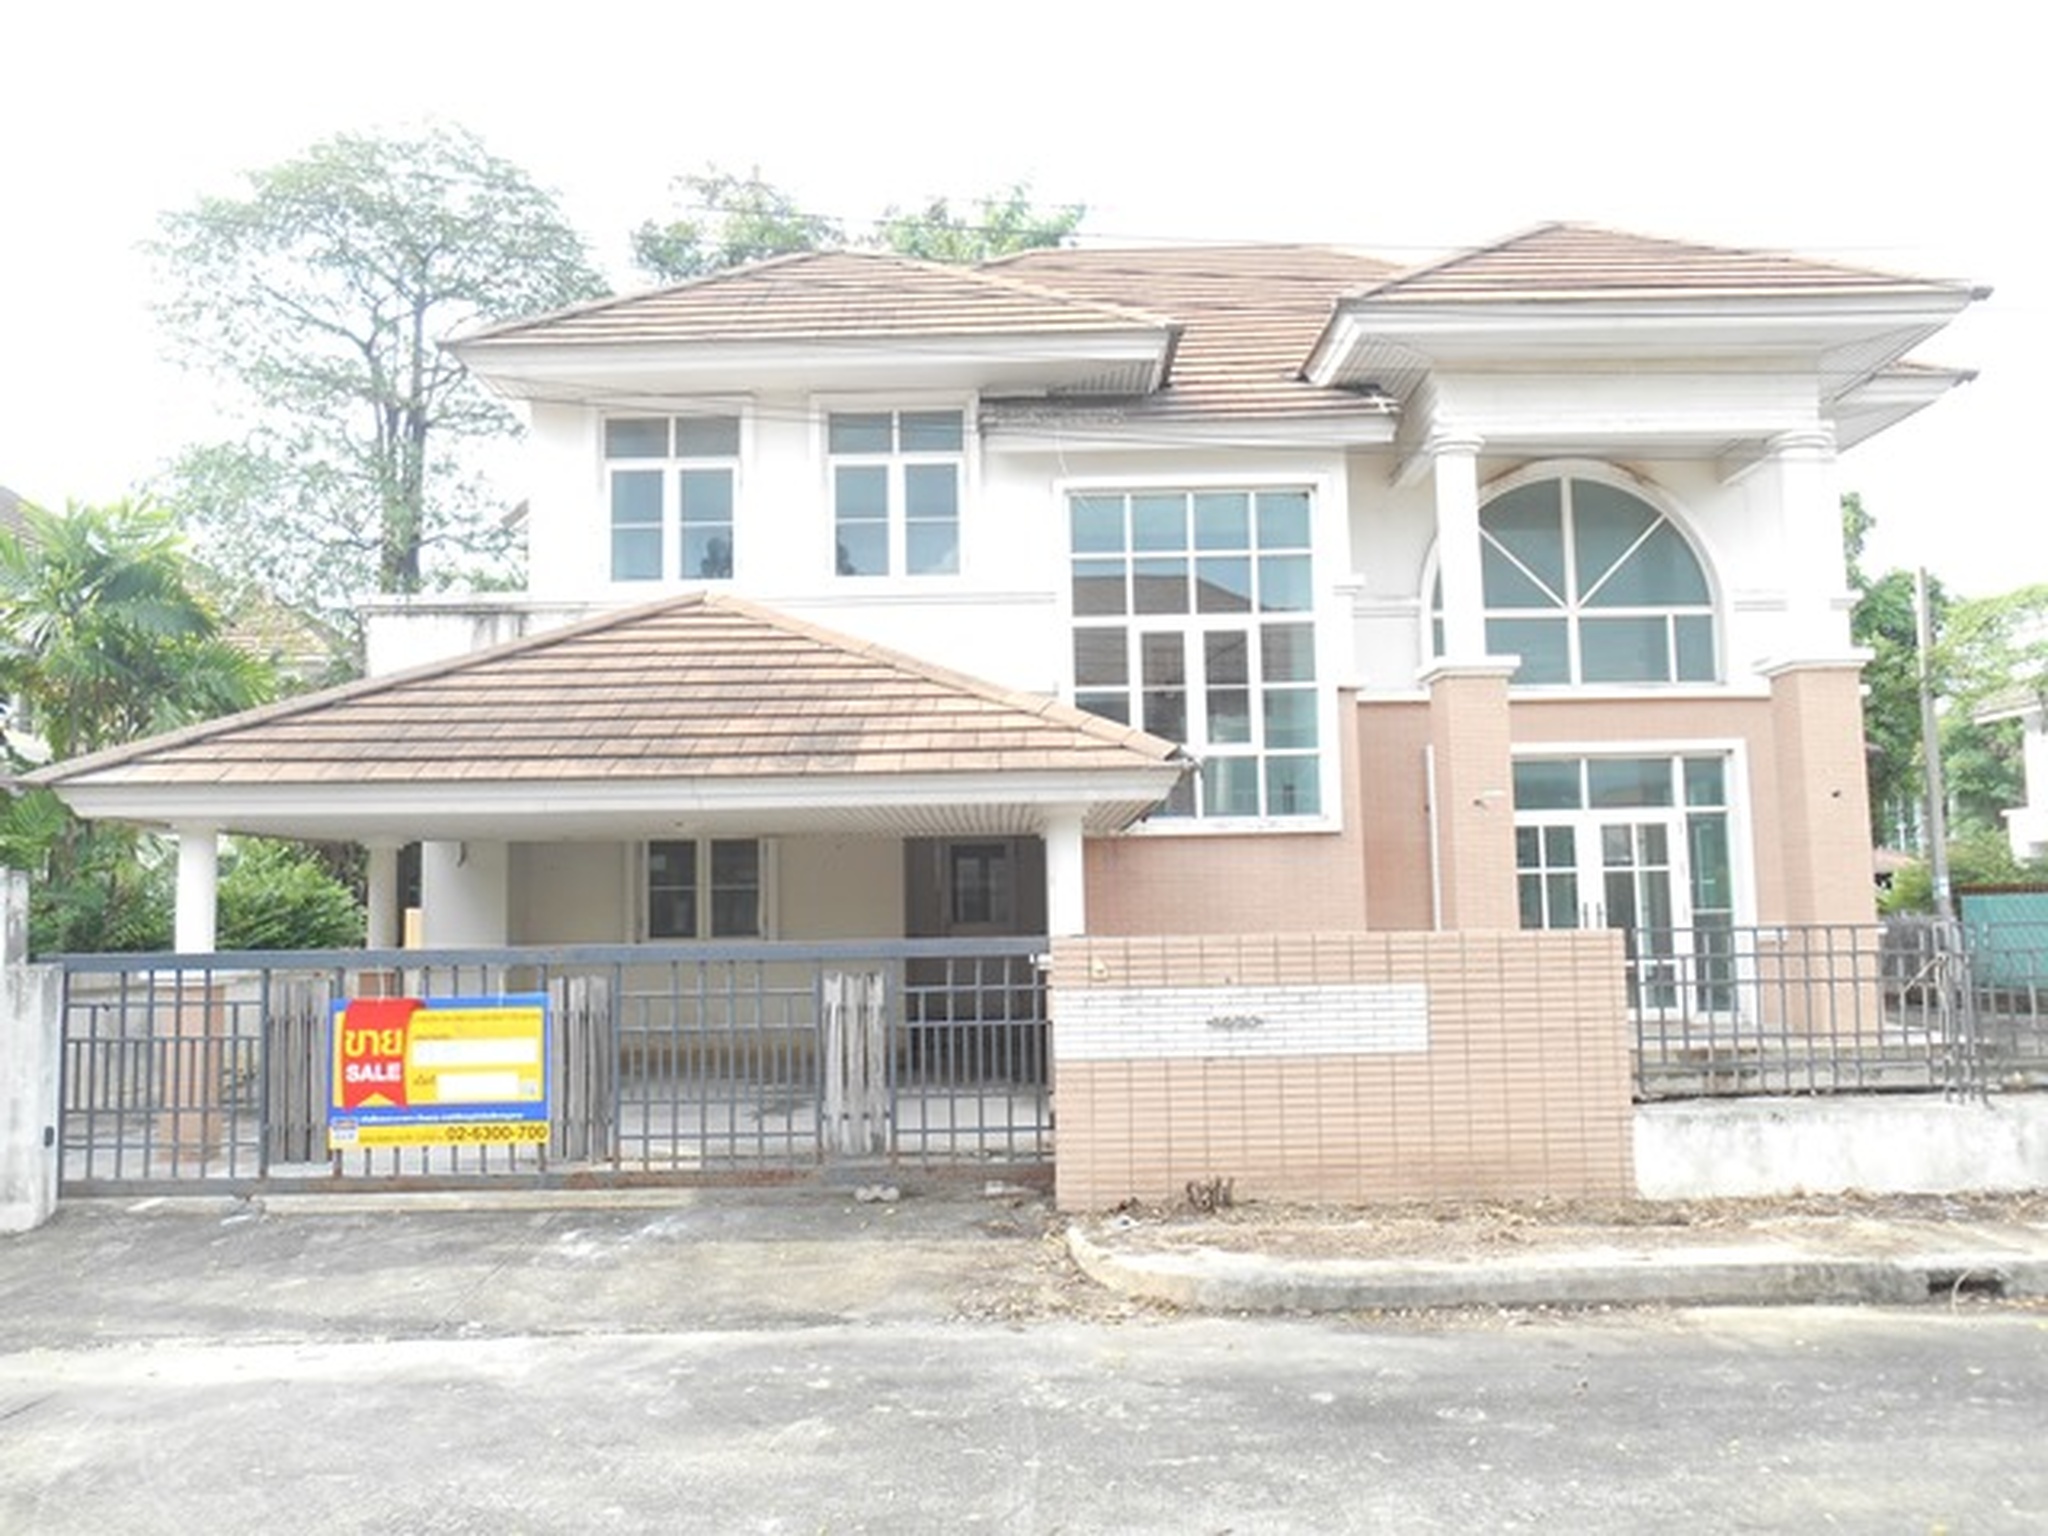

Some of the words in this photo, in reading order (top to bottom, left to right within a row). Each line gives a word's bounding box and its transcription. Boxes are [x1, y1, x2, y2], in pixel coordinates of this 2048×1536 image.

[345, 1029, 403, 1057] ขาย
[345, 1062, 402, 1083] SALE
[445, 1125, 548, 1140] 02-6300-700
